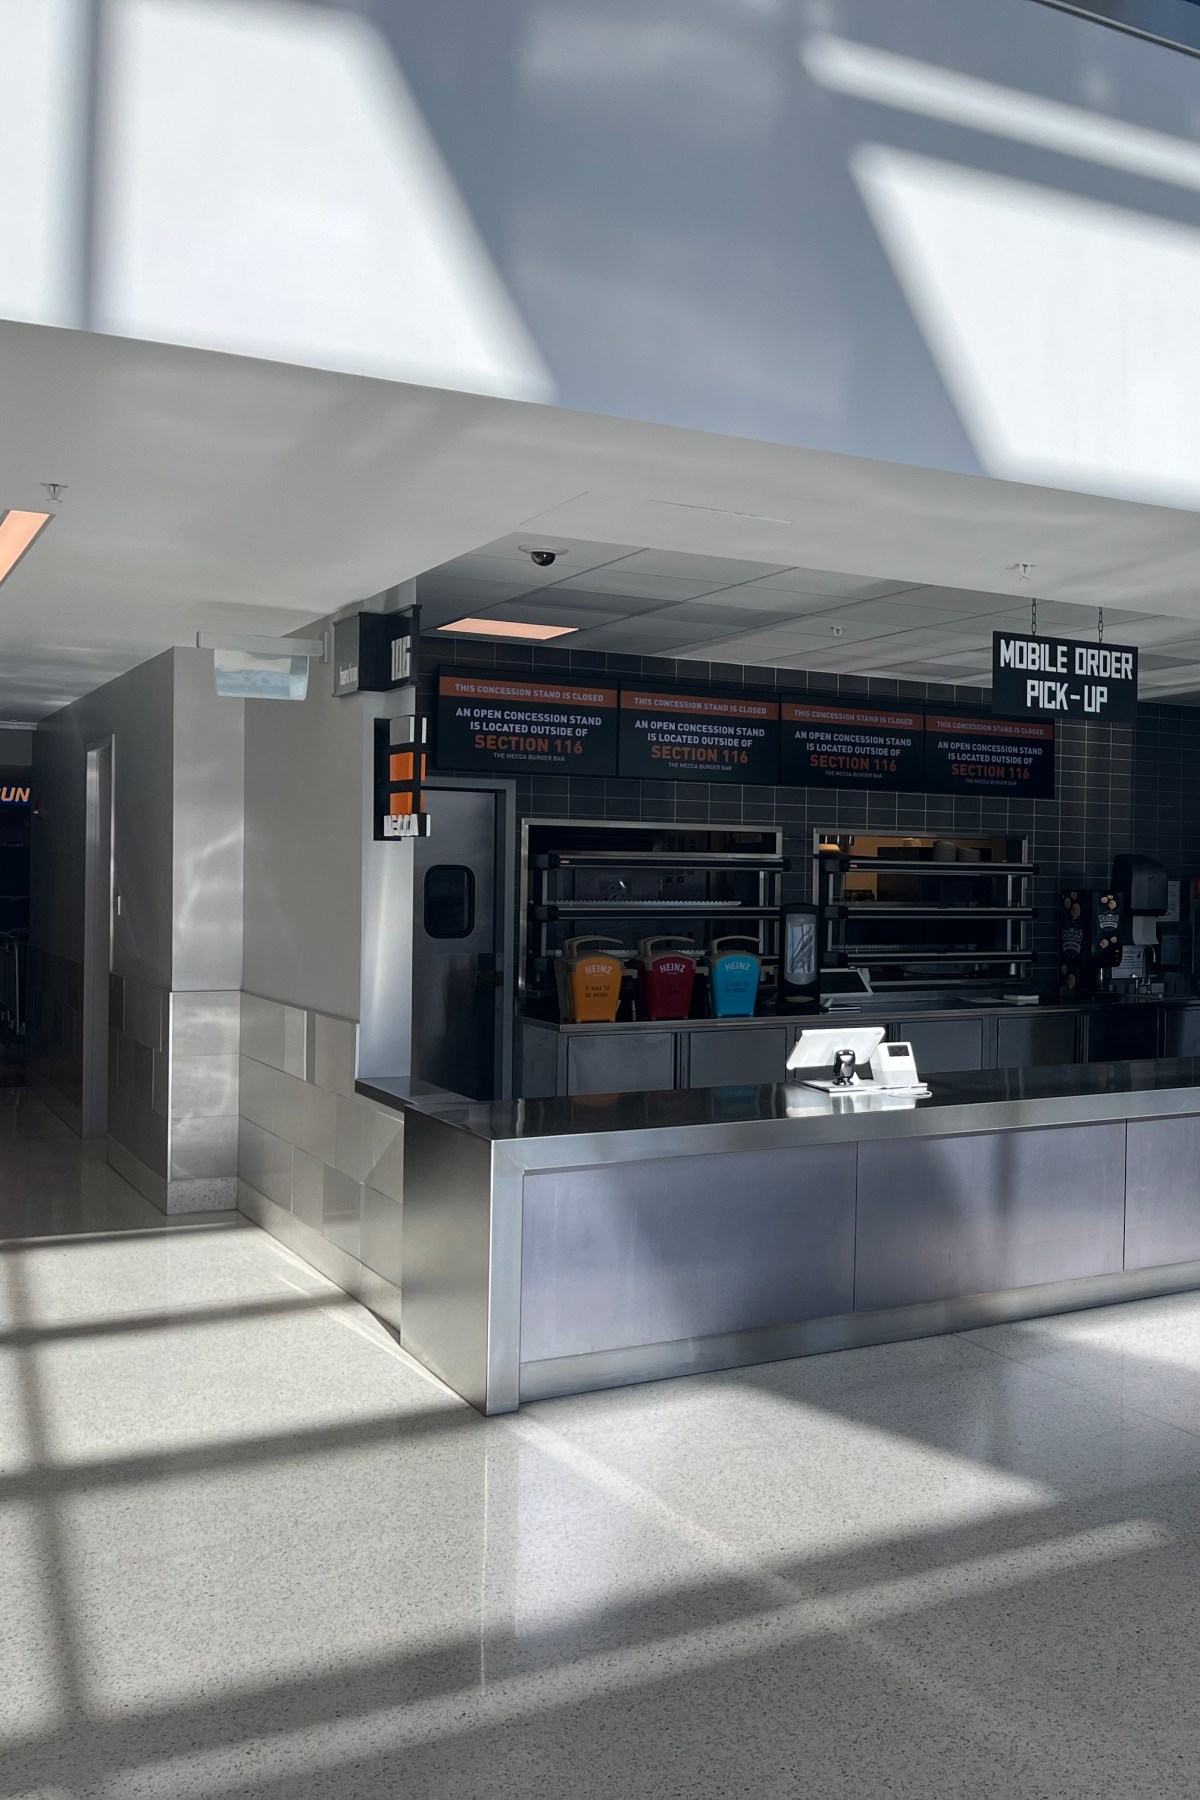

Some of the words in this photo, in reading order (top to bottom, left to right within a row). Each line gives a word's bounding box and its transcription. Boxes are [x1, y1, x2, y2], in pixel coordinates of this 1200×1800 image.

[1000, 639, 1067, 673] MOBILE
[1075, 648, 1133, 680] ORDER
[455, 684, 475, 692] THIS
[477, 685, 531, 696] CONCESSION
[533, 690, 560, 699] STAND
[572, 692, 604, 702] CLOSED
[1027, 680, 1107, 713] PICK-UP
[634, 697, 652, 705] THIS
[654, 699, 702, 709] CONCESSION
[704, 703, 728, 711] STAND
[739, 706, 767, 714] CLOSED
[456, 708, 470, 717] AN
[473, 709, 501, 719] OPEN
[504, 711, 567, 723] CONCESSION
[570, 715, 601, 725] STAND
[812, 711, 855, 720] CONCESSION
[470, 722, 480, 730] IS
[483, 722, 528, 733] LOCATED
[530, 726, 572, 736] OUTSIDE
[575, 729, 588, 737] OF
[635, 720, 648, 728] AN
[651, 721, 675, 730] OPEN
[678, 723, 734, 734] CONCESSION
[736, 728, 765, 736] STAND
[953, 722, 991, 731] CONCESSION
[475, 735, 548, 752] SECTION
[555, 739, 583, 754] 116
[659, 734, 699, 744] LOCATED
[701, 737, 739, 746] OUTSIDE
[809, 732, 831, 740] OPEN
[834, 734, 884, 744] CONCESSION
[886, 738, 911, 746] STAND
[651, 745, 718, 762] SECTION
[723, 750, 748, 763] 116
[816, 744, 852, 753] LOCATED
[854, 747, 888, 755] OUTSIDE
[938, 741, 948, 749] AN
[950, 742, 970, 750] OPEN
[972, 744, 1018, 753] CONCESSION
[1019, 747, 1043, 755] STAND
[810, 754, 869, 770] SECTION
[874, 758, 896, 772] 116
[957, 753, 990, 762] LOCATED
[992, 756, 1022, 764] OUTSIDE
[952, 763, 1004, 778] SECTION
[1009, 767, 1030, 779] 116
[0, 786, 31, 802] UN
[585, 964, 613, 975] HEINZ
[659, 963, 685, 973] HEINZ
[725, 962, 751, 971] HEINZ
